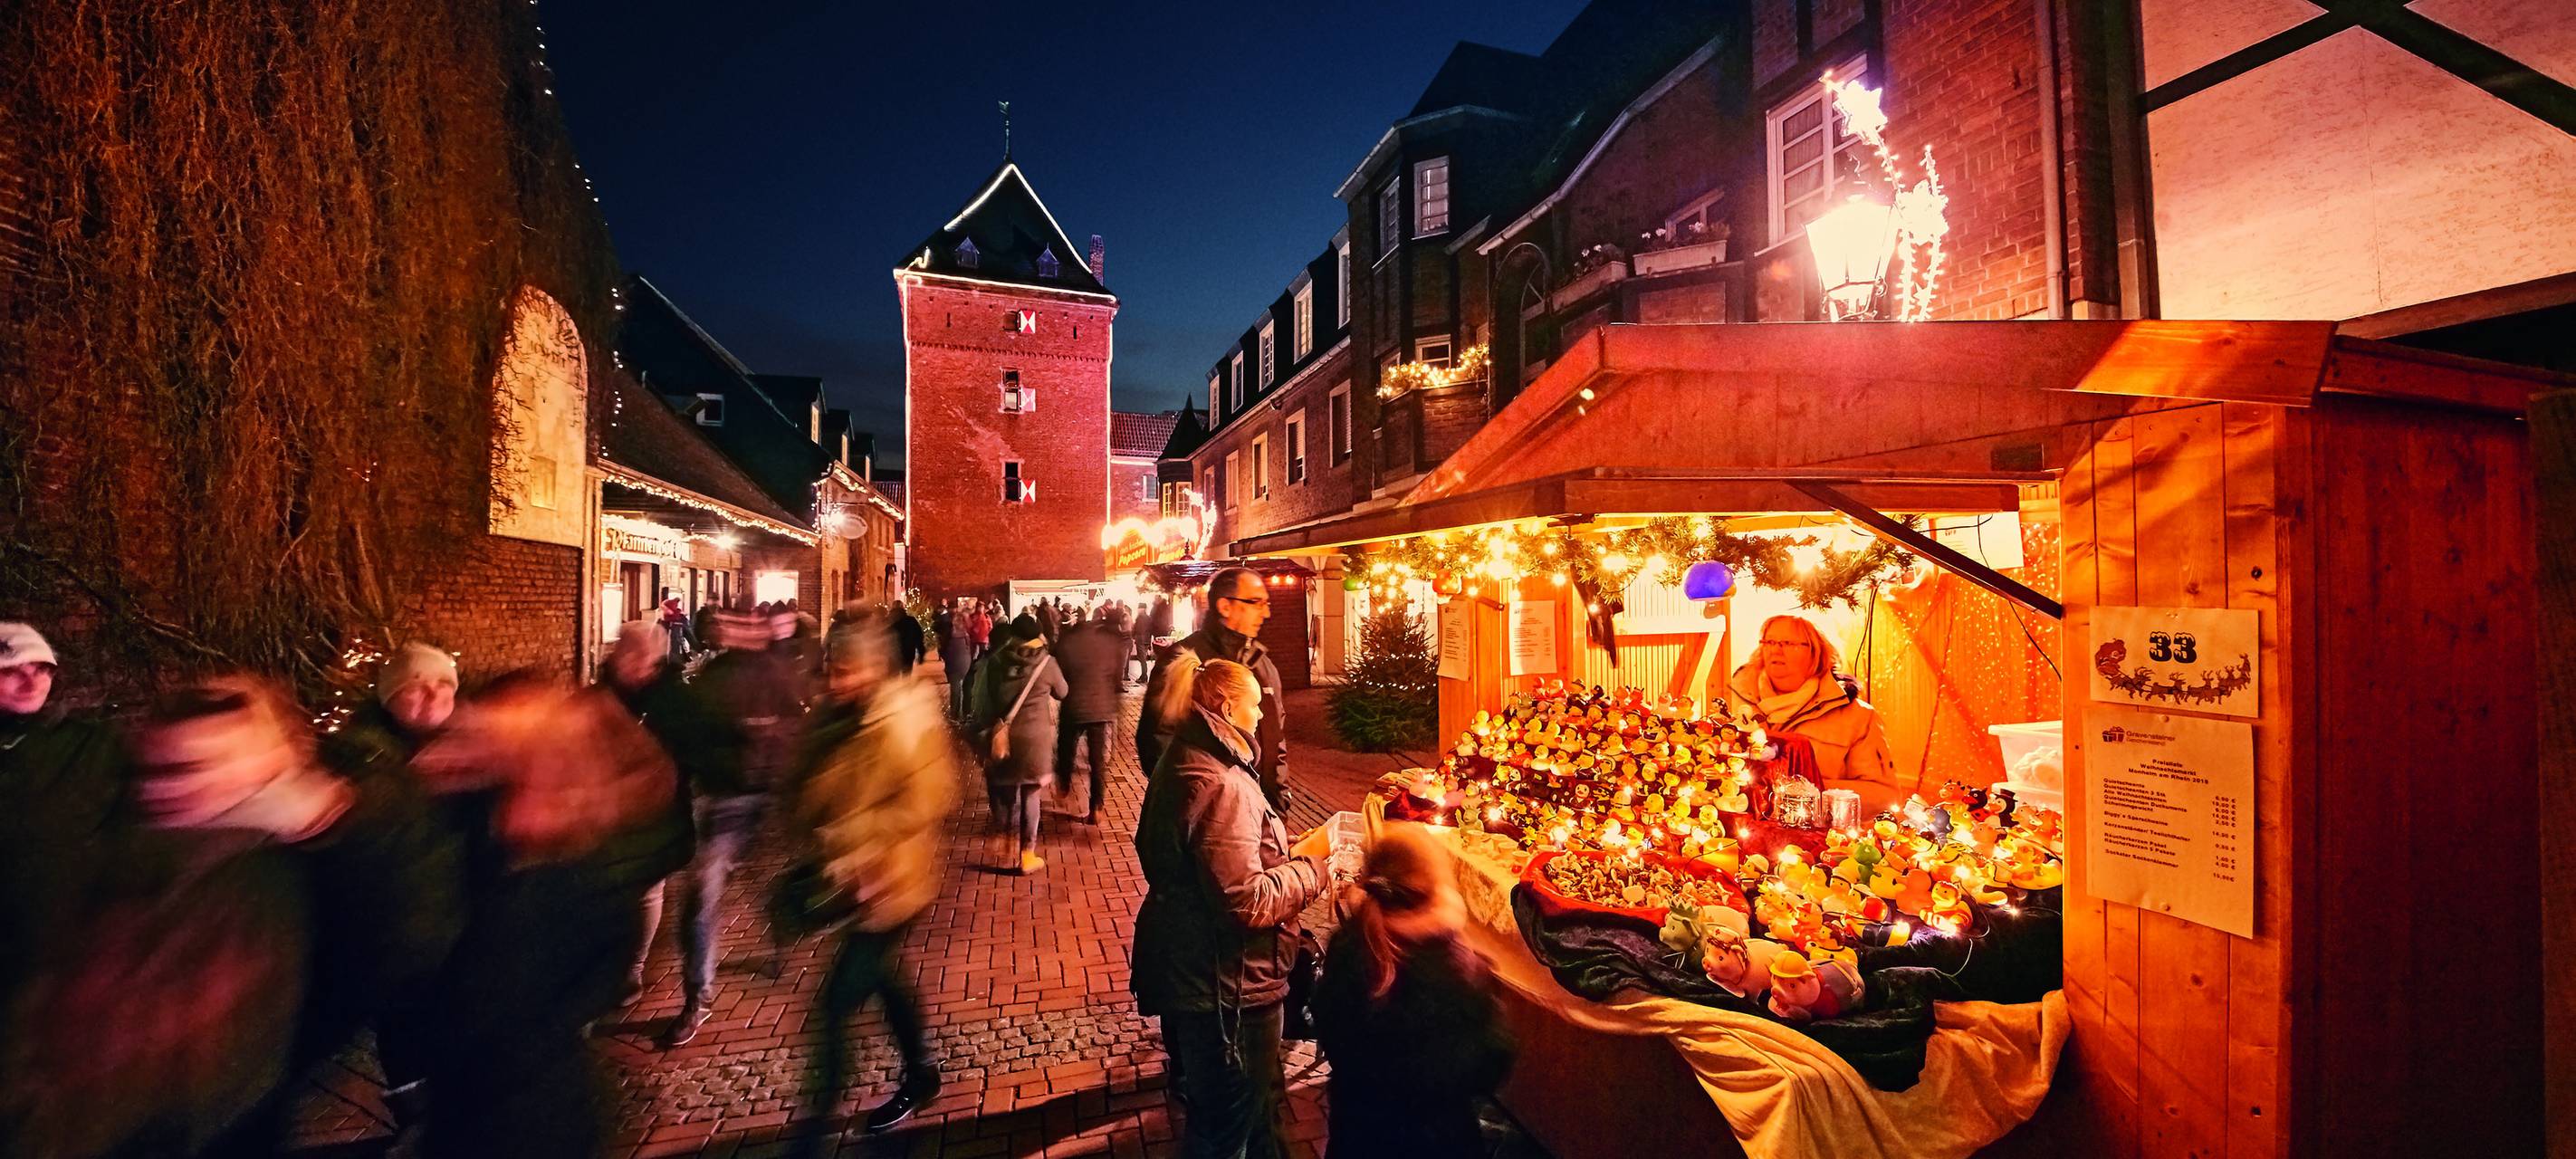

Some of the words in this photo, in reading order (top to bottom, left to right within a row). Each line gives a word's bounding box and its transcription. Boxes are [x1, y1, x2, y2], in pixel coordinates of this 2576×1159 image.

[1118, 547, 1146, 567] Popcorn
[2148, 631, 2198, 664] 33
[2140, 763, 2198, 776] Weihnachtsmarkt
[2152, 759, 2183, 768] Preisliste
[2128, 768, 2158, 776] Monheim
[2170, 774, 2190, 782] Rhein
[2103, 778, 2145, 789] Quietscheente
[2103, 784, 2149, 795] Quietscheenten
